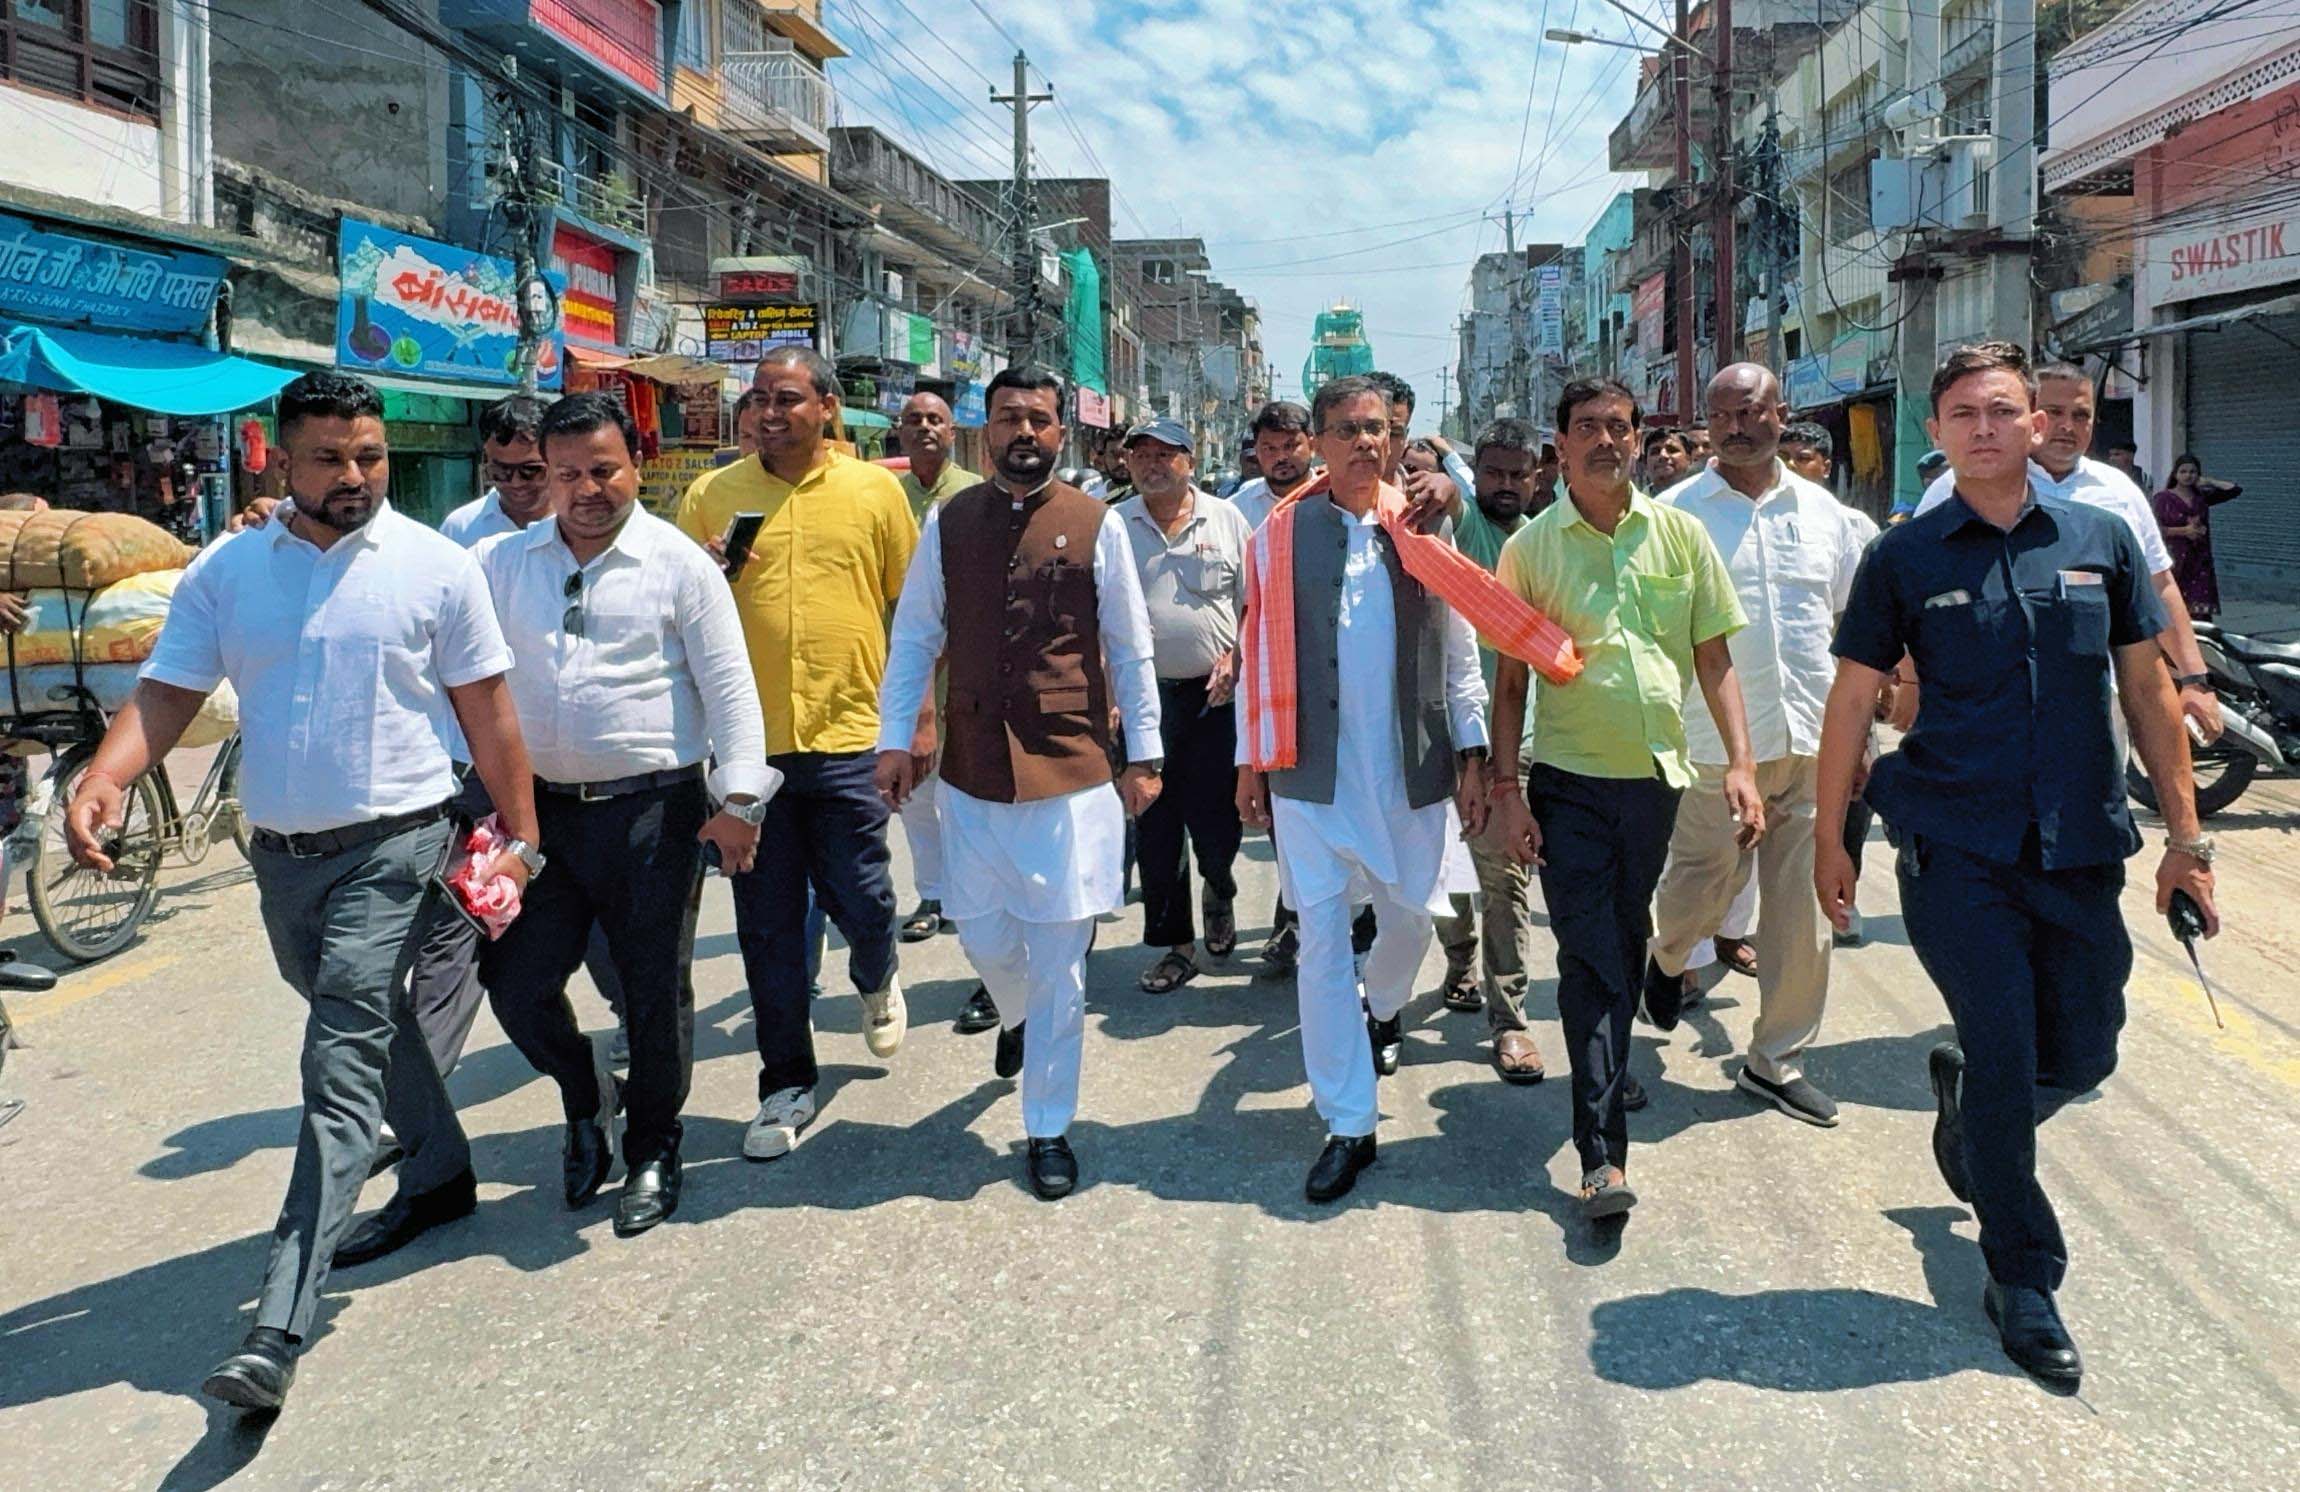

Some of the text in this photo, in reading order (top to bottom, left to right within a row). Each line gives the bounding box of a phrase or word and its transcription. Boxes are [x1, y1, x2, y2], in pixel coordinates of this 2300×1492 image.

[2171, 221, 2287, 281] SWASTIK
[730, 330, 768, 340] LAPTOP
[771, 329, 809, 338] MOBILE
[684, 457, 716, 470] SALES
